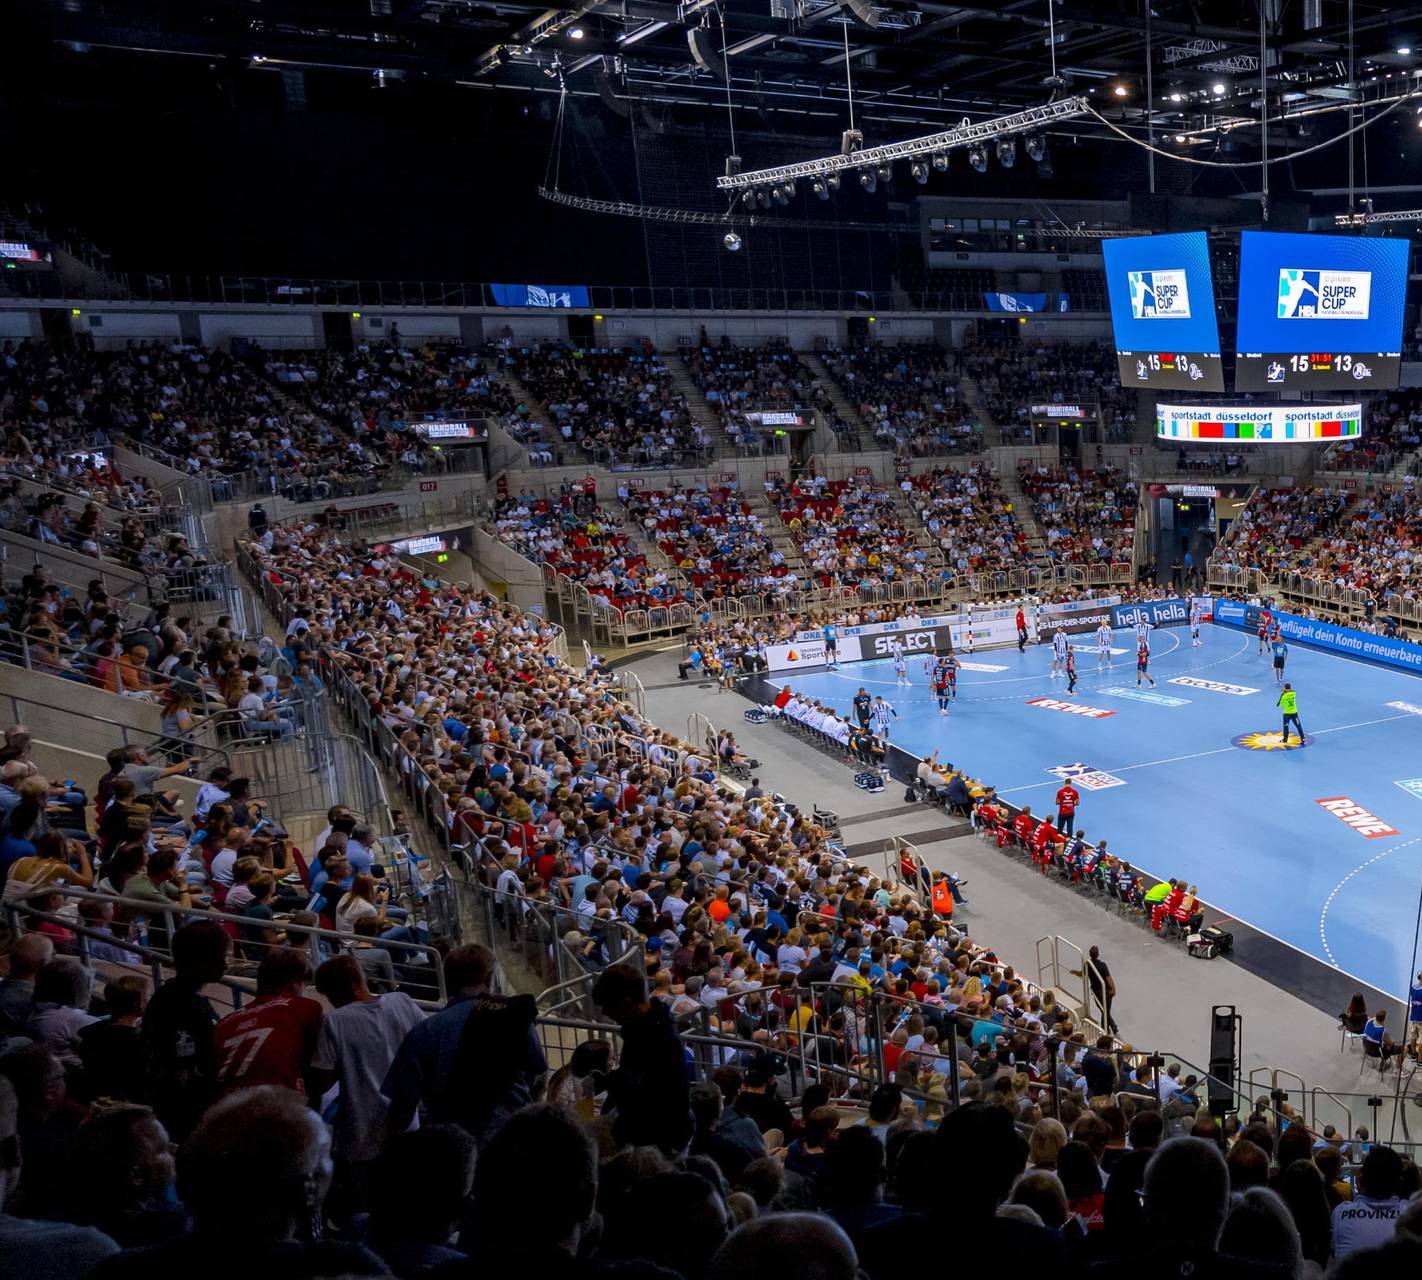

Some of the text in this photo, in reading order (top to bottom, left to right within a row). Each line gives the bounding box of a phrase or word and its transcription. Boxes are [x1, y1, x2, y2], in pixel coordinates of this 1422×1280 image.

[1156, 285, 1178, 297] SUPER
[1323, 286, 1356, 298] SUPER
[1157, 298, 1173, 309] CUP
[1322, 298, 1346, 310] CUP
[1148, 354, 1160, 371] 15
[1175, 355, 1188, 372] 13
[1290, 355, 1309, 372] 15
[1334, 355, 1352, 372] 13
[1171, 411, 1273, 421] sportstadt düsseldorf
[1286, 410, 1333, 421] sportstadt
[428, 423, 468, 432] HANDBALL
[422, 483, 435, 491] 017
[1117, 610, 1150, 626] hella
[1154, 604, 1186, 622] hella
[884, 623, 900, 631] DKB
[922, 618, 938, 626] DKB
[803, 630, 821, 639] DKB
[844, 627, 861, 636] DKB
[1278, 618, 1314, 638] beflügelt
[1315, 627, 1334, 642] dein
[1336, 633, 1362, 650] Konto
[1363, 642, 1421, 664] erneuerbare
[1033, 699, 1112, 718] REWE
[1319, 798, 1395, 836] REWE
[219, 1027, 274, 1081] 77
